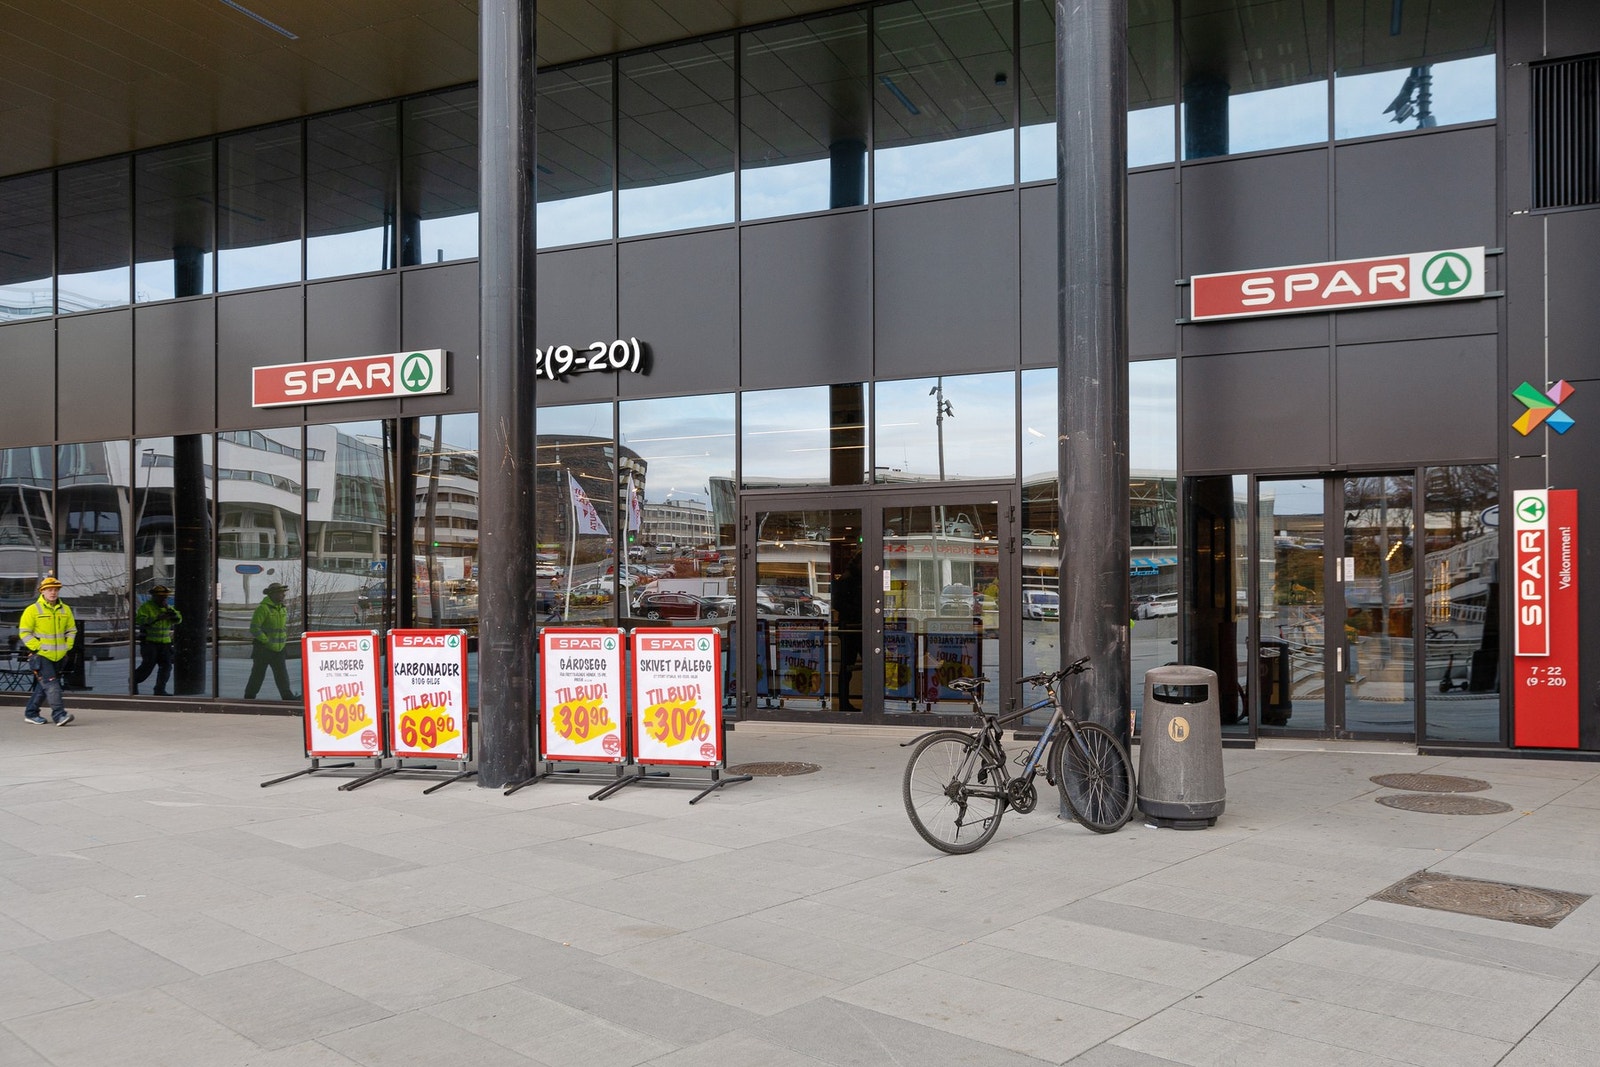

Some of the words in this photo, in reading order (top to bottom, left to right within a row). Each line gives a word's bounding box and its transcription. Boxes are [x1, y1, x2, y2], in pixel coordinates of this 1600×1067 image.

[1241, 264, 1406, 306] SPAR
[284, 362, 391, 396] SPAR
[1559, 526, 1571, 590] Velkommen!
[1521, 531, 1542, 626] SPAR
[319, 641, 357, 651] SPAR
[402, 636, 445, 646] SPAR
[559, 638, 601, 648] SPAR
[650, 639, 694, 649] SPAR
[319, 659, 364, 671] JARLSBERG
[394, 663, 460, 677] KARBONADER
[559, 656, 607, 671] GÅRDSEGG
[640, 659, 672, 672] SKIVET
[675, 657, 712, 672] PÅLEGG
[1530, 666, 1539, 675] 7
[1547, 666, 1562, 676] 22
[317, 681, 364, 702] TILBUD!
[402, 690, 452, 711] TILBUD!
[555, 682, 608, 704] TILBUD!
[645, 683, 702, 705] TILBUD!
[643, 707, 710, 742] -30%
